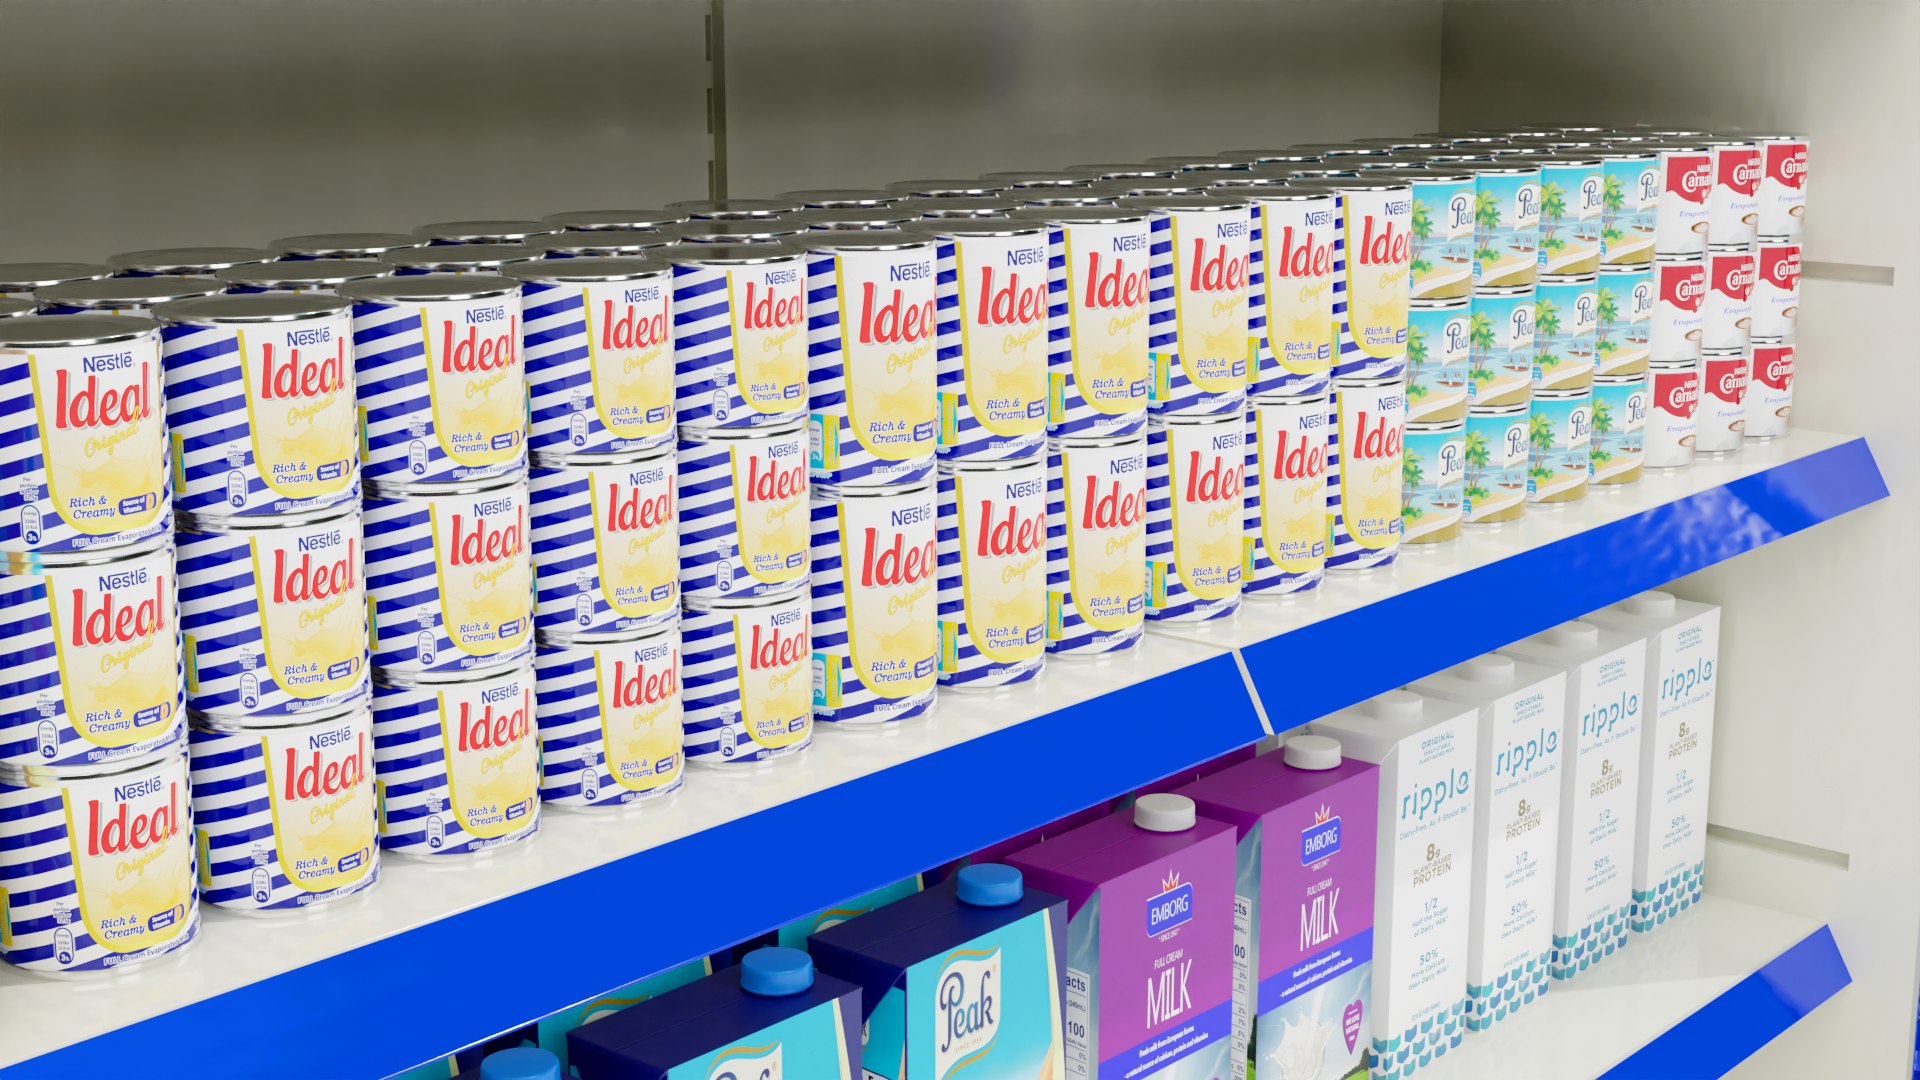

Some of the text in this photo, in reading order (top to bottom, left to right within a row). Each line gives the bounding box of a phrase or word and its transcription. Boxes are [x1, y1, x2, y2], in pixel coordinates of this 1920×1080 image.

[765, 269, 796, 285] Nestlé
[889, 261, 931, 283] Nestlé
[624, 288, 660, 303] Nestlé
[744, 278, 804, 329] Ideal
[465, 305, 505, 324] Nestlé
[602, 295, 668, 349] Ideal
[287, 325, 331, 347] Nestlé
[442, 314, 515, 372] Ideal
[82, 352, 133, 374] Nestlé
[262, 336, 344, 399] Ideal
[56, 361, 151, 429] Ideal
[767, 442, 800, 458] Nestlé
[272, 462, 308, 474] Rich &
[276, 472, 314, 485] Creamy
[629, 468, 664, 485] Nestlé
[747, 449, 807, 502] Ideal
[69, 496, 108, 508] Rich &
[73, 506, 116, 520] Creamy
[473, 497, 512, 518] Nestlé
[608, 475, 673, 532] Ideal
[891, 502, 930, 528] Nestlé
[296, 529, 342, 553] Nestlé
[450, 505, 523, 565] Ideal
[98, 567, 148, 592] Nestlé
[274, 539, 355, 604] Ideal
[73, 576, 165, 646] Ideal
[770, 609, 802, 626] Nestlé
[750, 613, 808, 670] Ideal
[634, 644, 668, 663] Nestlé
[284, 663, 318, 676] Rich &
[288, 672, 325, 686] Creamy
[613, 649, 677, 708] Ideal
[481, 682, 519, 704] Nestlé
[1514, 692, 1544, 710] ORIGINAL
[85, 709, 123, 722] Rich &
[90, 718, 130, 734] Creamy
[458, 688, 529, 752] Ideal
[309, 726, 350, 750] Nestlé
[1421, 732, 1454, 750] ORIGINAL
[1496, 728, 1557, 778] ripple
[285, 733, 365, 800] Ideal
[113, 776, 161, 804] Nestlé
[1402, 768, 1468, 820] ripple
[1590, 778, 1622, 799] PROTEIN
[1518, 799, 1531, 817] 8g
[89, 783, 179, 856] Ideal
[1506, 817, 1541, 840] PROTEIN
[1305, 826, 1338, 856] EMBORG
[296, 856, 329, 870] Rich &
[1426, 843, 1440, 862] 8g
[1516, 851, 1528, 866] 1/2
[298, 866, 336, 880] Creamy
[1413, 862, 1452, 888] PROTEIN
[1307, 886, 1318, 896] FULL
[1151, 894, 1189, 926] EMBORG
[1424, 897, 1438, 913] 1/2
[1511, 899, 1528, 916] 50%
[100, 915, 138, 930] Rich &
[1300, 888, 1340, 952] MILK
[104, 924, 146, 940] Creamy
[1154, 948, 1184, 970] FULL CREAM
[1419, 947, 1439, 966] 50%
[1066, 976, 1086, 992] acts
[1147, 958, 1192, 1030] MILK
[940, 970, 994, 1053] Peak
[1068, 1020, 1085, 1038] 100
